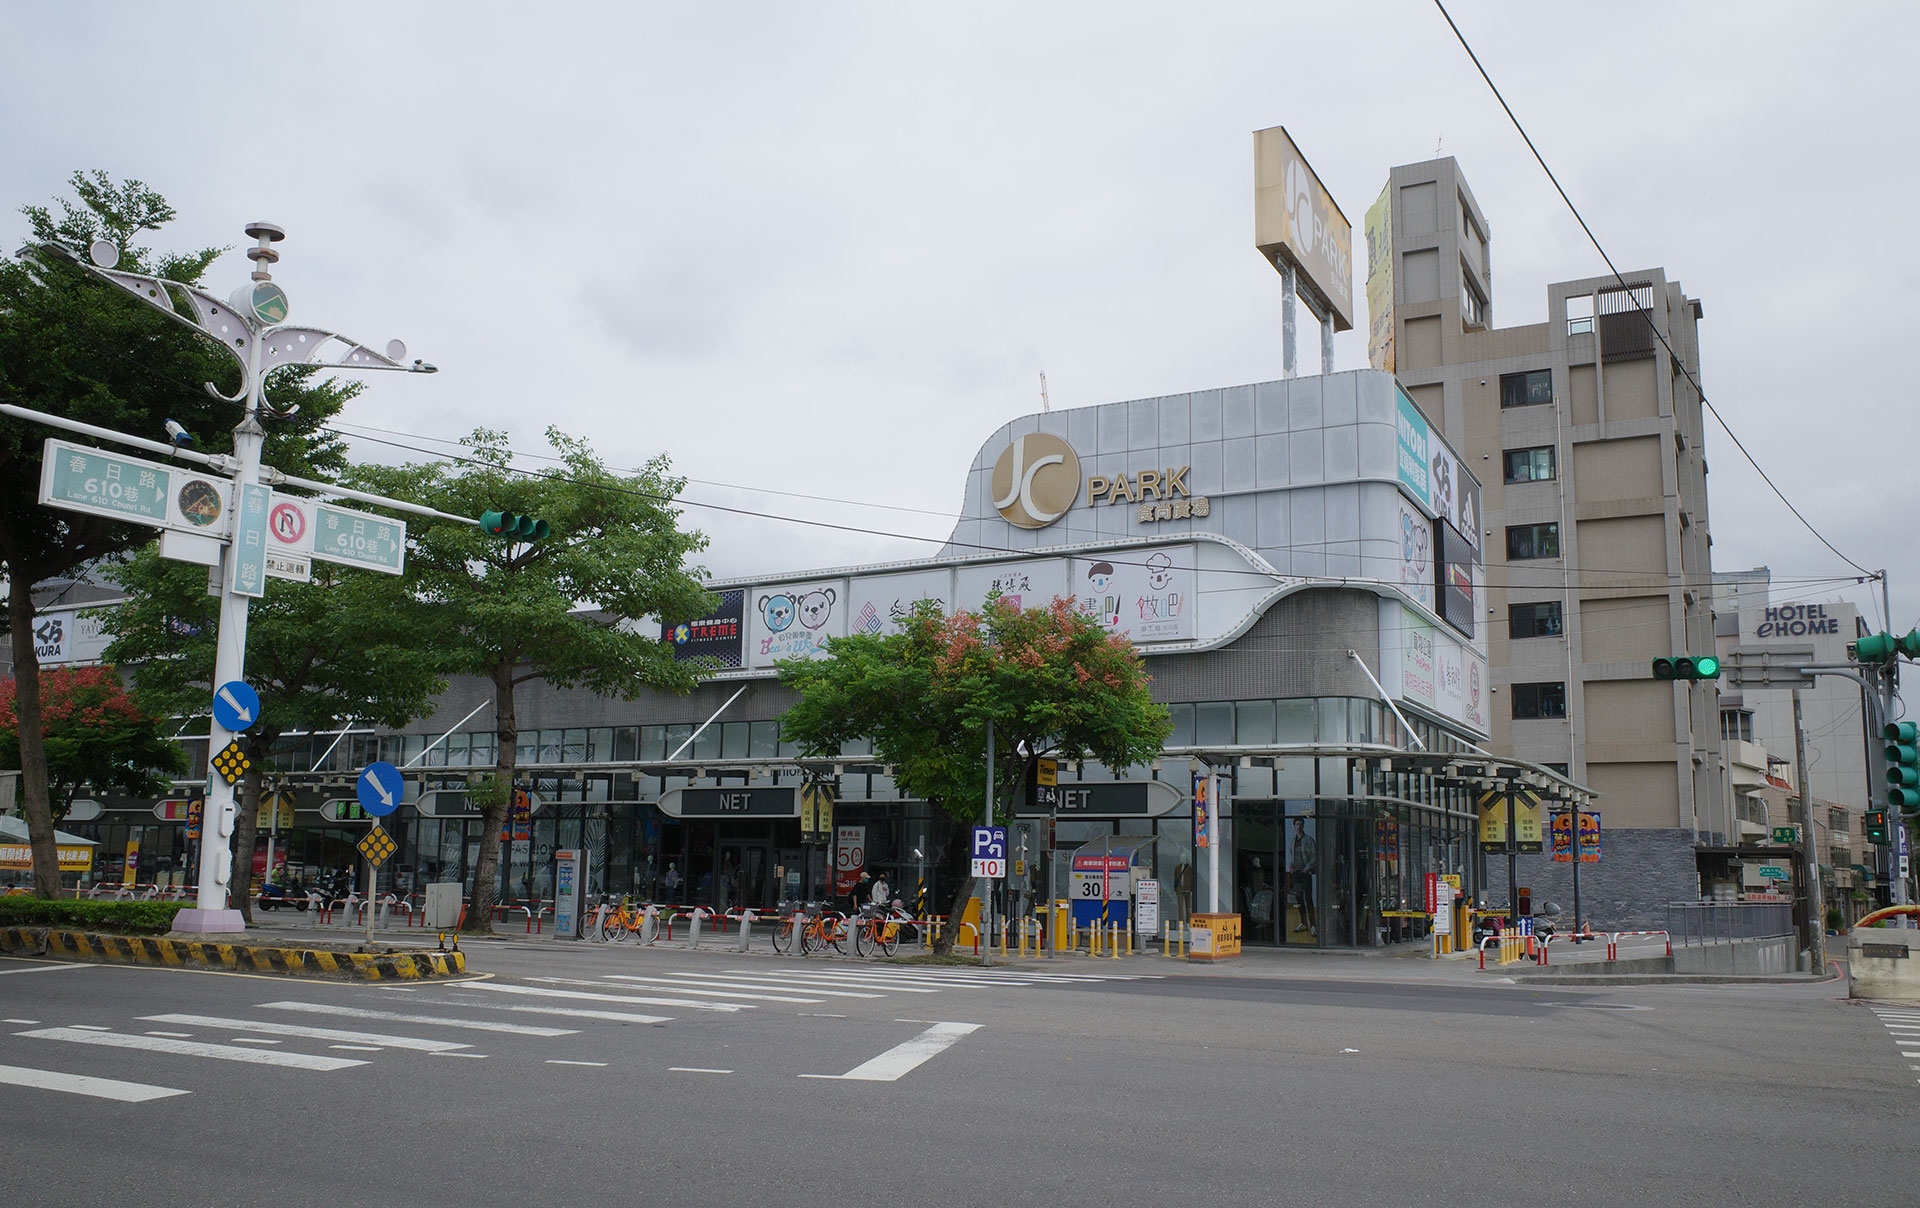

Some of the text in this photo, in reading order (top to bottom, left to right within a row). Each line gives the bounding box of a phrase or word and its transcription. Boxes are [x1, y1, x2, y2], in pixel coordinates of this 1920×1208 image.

[1313, 212, 1347, 286] PARK
[1399, 409, 1426, 463] NITORI
[69, 455, 156, 489] 春日路
[993, 436, 1191, 522] JC PARK
[67, 490, 87, 500] Lane
[91, 495, 107, 505] 610
[112, 499, 137, 511] Chunri
[1137, 496, 1210, 523] 食尚廣場
[241, 498, 263, 581] 春日路
[325, 514, 391, 542] 春日路
[1765, 604, 1827, 621] HOTEL
[667, 623, 738, 645] EXTREME
[35, 644, 61, 657] KURA
[719, 793, 752, 811] NET
[975, 830, 993, 855] P
[980, 861, 998, 876] 10
[1082, 882, 1100, 897] 30
